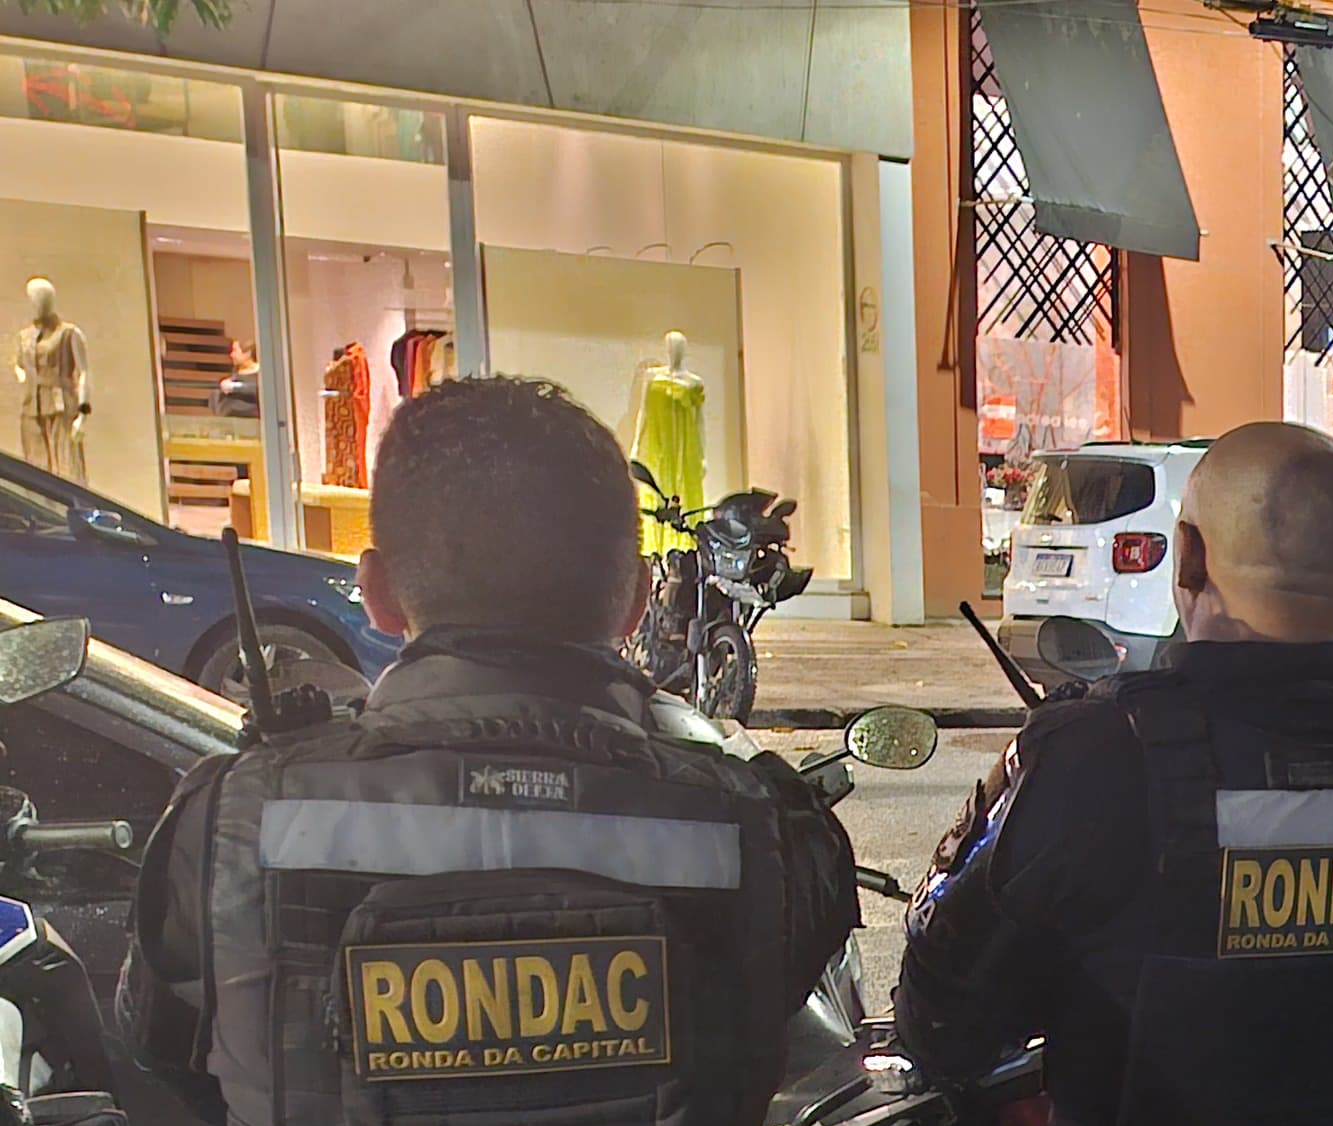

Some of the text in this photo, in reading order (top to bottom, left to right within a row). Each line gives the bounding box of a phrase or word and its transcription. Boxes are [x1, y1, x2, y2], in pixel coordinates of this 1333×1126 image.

[505, 768, 569, 787] SIERRA
[1226, 932, 1298, 950] RONDA
[1303, 931, 1330, 946] DA
[361, 950, 649, 1044] RONDAC
[368, 1037, 656, 1071] RONDA DA CAPITAL
